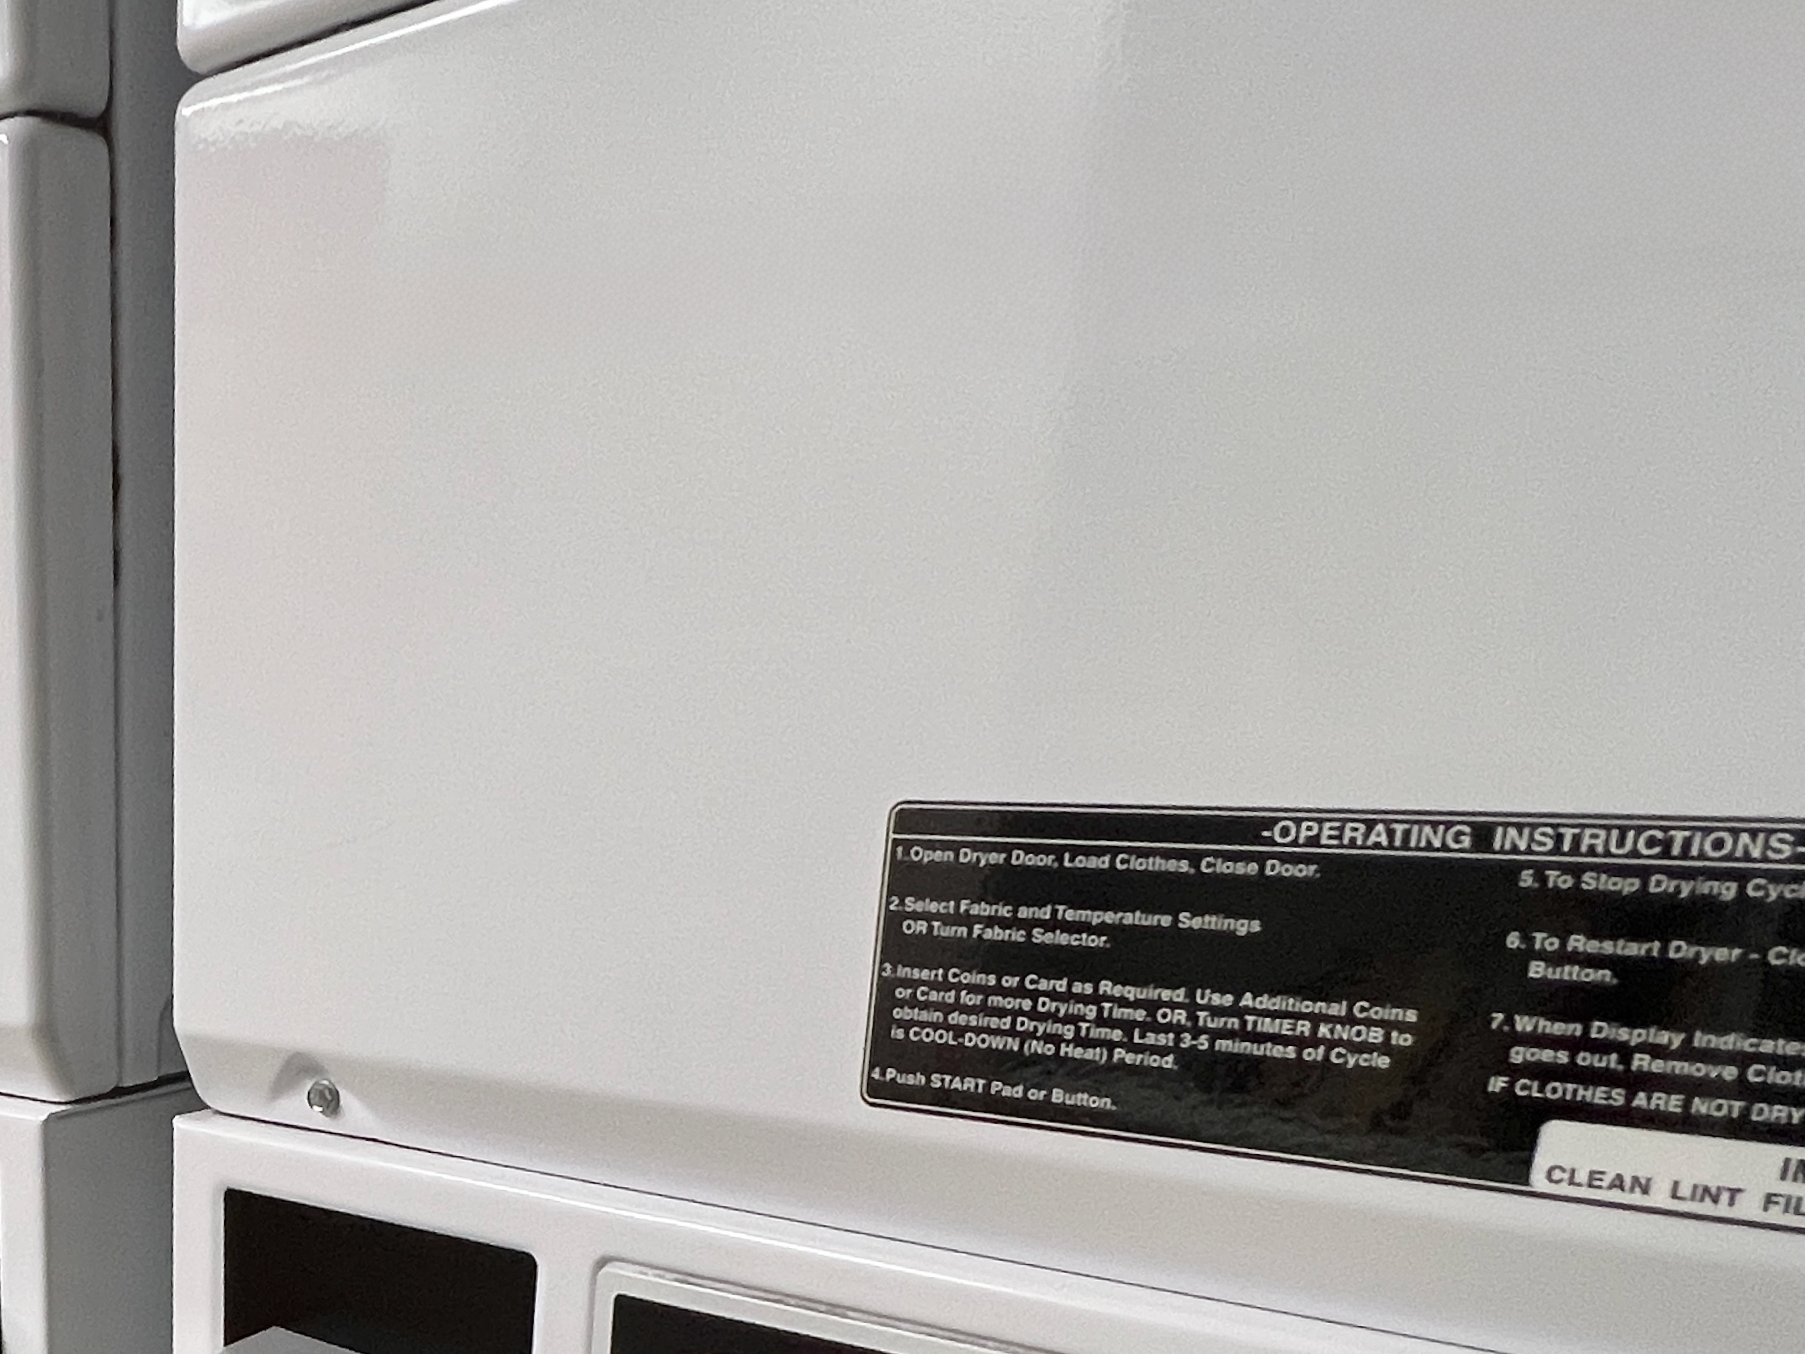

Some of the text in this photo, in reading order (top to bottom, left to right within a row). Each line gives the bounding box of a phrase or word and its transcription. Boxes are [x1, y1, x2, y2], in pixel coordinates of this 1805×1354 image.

[1261, 820, 1473, 851] -OPERATING
[959, 848, 1007, 867] Dryer
[1063, 852, 1110, 869] Load
[1200, 856, 1259, 875] Close
[1264, 859, 1321, 878] Door.
[1518, 869, 1538, 888] 5.
[1545, 870, 1574, 889] To
[1581, 872, 1640, 895] Stop
[1649, 874, 1738, 900] Drying
[902, 920, 1111, 948] OR Turn Fabric Selector.
[959, 900, 1013, 917] Fabric
[1018, 904, 1051, 920] and
[1056, 905, 1172, 927] Temperature
[1178, 912, 1262, 936] Settings
[1506, 931, 1526, 949] 6.
[1531, 932, 1559, 951] To
[1567, 935, 1661, 957] Restart
[1668, 940, 1744, 965] Dryer
[1527, 961, 1618, 985] Button.
[948, 969, 996, 986] Coins
[1001, 975, 1020, 988] or
[1024, 974, 1067, 992] Card
[1072, 980, 1093, 994] as
[1098, 980, 1190, 1003] Required.
[1195, 988, 1234, 1006] Use
[1239, 992, 1346, 1016] Additional
[1352, 1001, 1418, 1022] Coins
[895, 987, 913, 999] or
[916, 986, 955, 1004] Card
[959, 990, 984, 1006] for
[987, 995, 1032, 1011] more
[1037, 997, 1097, 1020] Drying
[1100, 1002, 1152, 1022] Time.
[1196, 1011, 1240, 1030] Turn
[1244, 1015, 1311, 1038] TIMER
[1317, 1022, 1385, 1044] KNOB
[1391, 1030, 1413, 1046] to
[891, 1025, 1178, 1070] is COOL-DOWN (No Heat) Period.
[892, 1007, 1391, 1069] obtain desired Drying Time. Last 3-5 minutes of Cycle
[1590, 1021, 1686, 1049] Display
[1509, 1046, 1569, 1064] goes
[1630, 1053, 1738, 1080] Remove
[1746, 1064, 1805, 1088] Clot
[930, 1073, 986, 1094] START
[990, 1081, 1023, 1098] Pad
[1027, 1086, 1047, 1100] or
[1051, 1088, 1118, 1111] Button.
[1487, 1076, 1805, 1124] IF CLOTHES ARE NOT DRY
[1546, 1165, 1805, 1216] CLEAN LINT FIL
